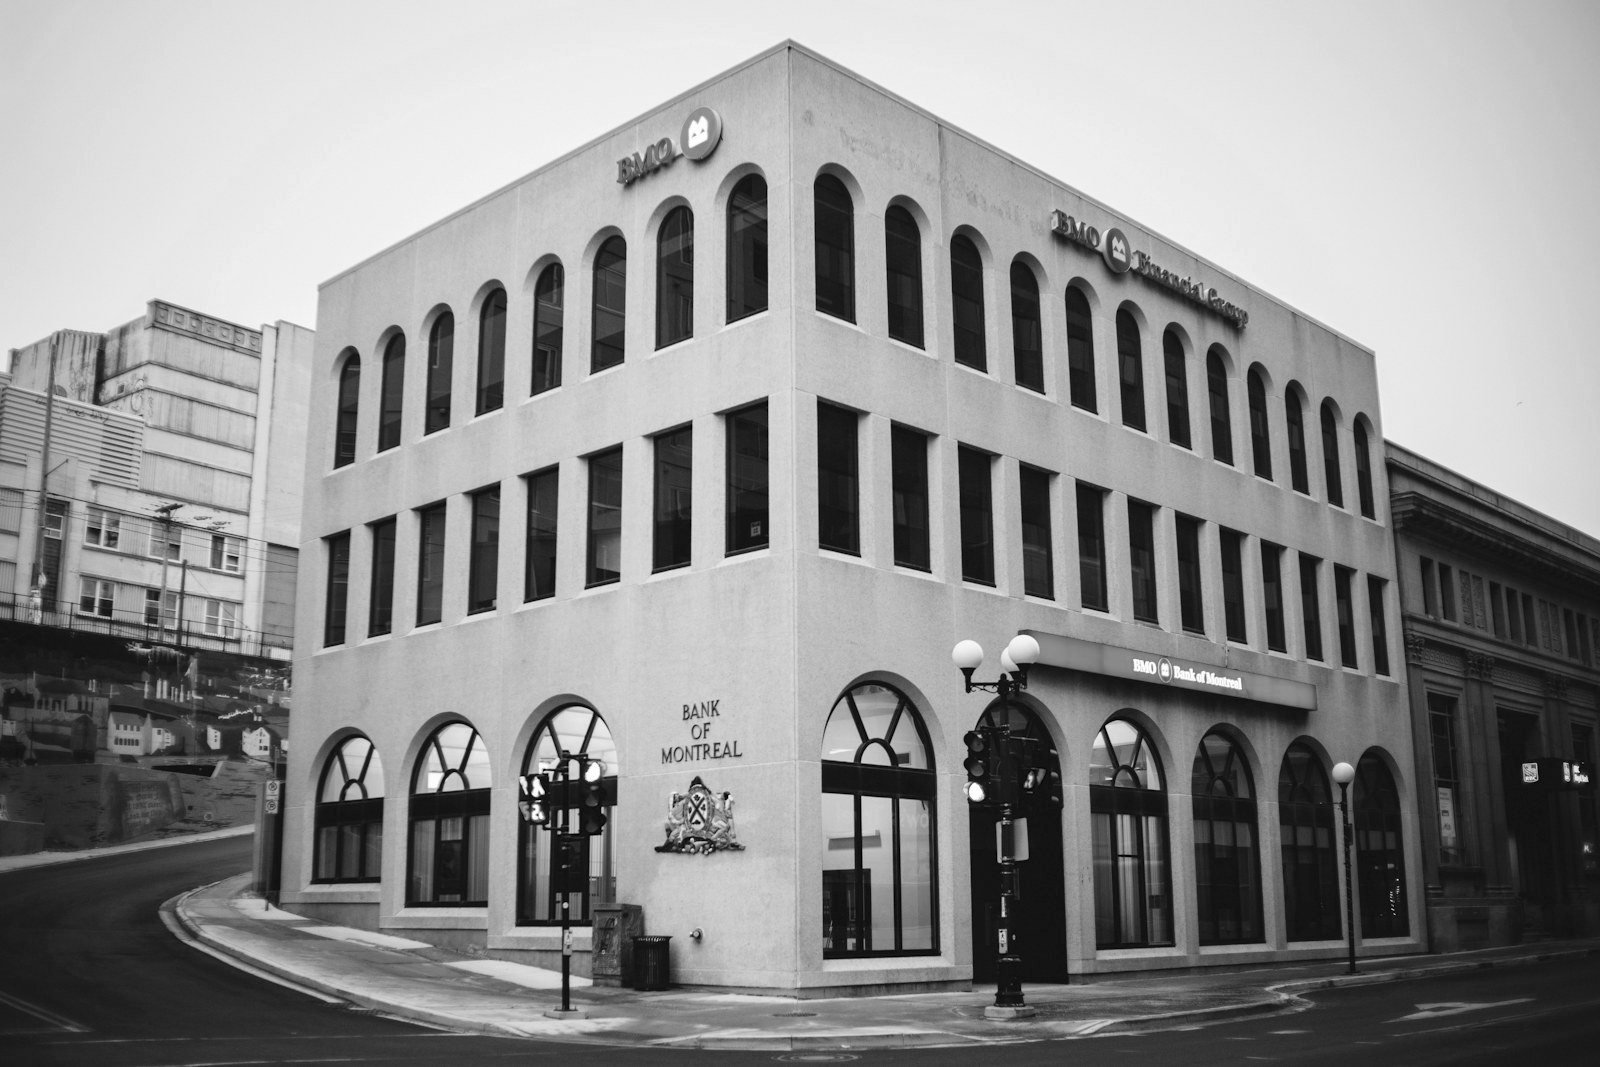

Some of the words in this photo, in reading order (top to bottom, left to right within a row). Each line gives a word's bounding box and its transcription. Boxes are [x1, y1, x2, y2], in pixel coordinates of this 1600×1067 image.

[616, 137, 674, 184] BMO
[1051, 208, 1101, 249] BMO
[1133, 250, 1205, 300] Financial
[1205, 287, 1250, 330] Group
[1133, 659, 1156, 675] BMO
[1173, 666, 1196, 681] Bank
[1197, 671, 1206, 683] of
[1206, 672, 1242, 690] Montreal
[682, 699, 721, 721] BANK
[691, 722, 711, 740] OF
[661, 740, 743, 765] MONTREAL
